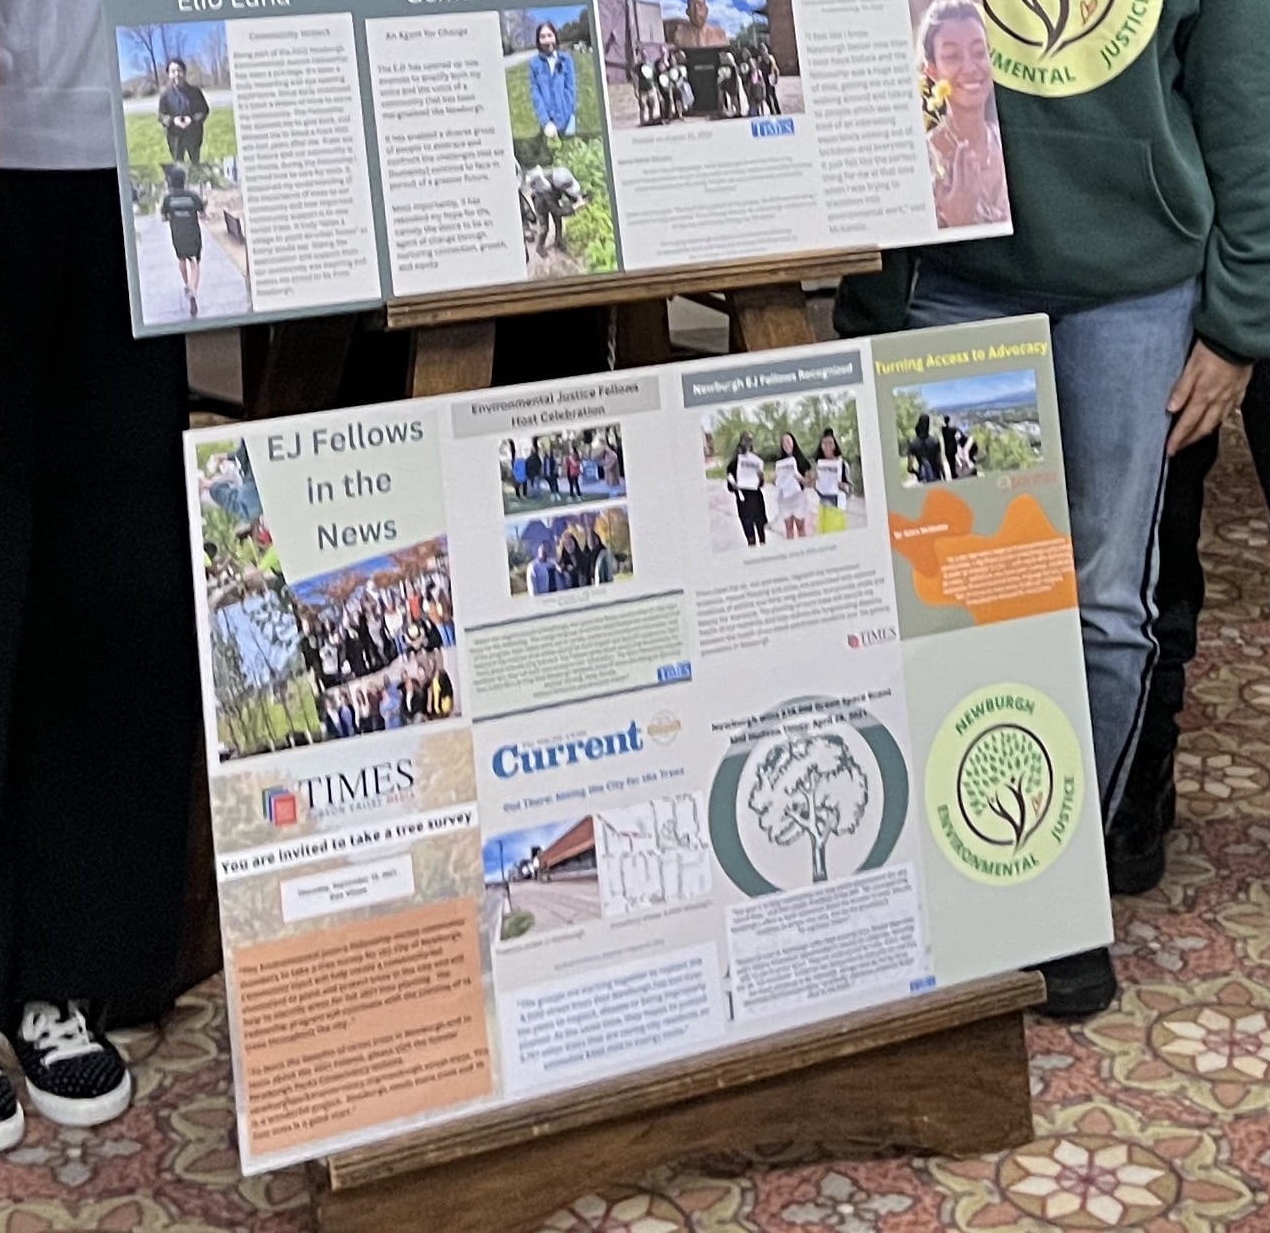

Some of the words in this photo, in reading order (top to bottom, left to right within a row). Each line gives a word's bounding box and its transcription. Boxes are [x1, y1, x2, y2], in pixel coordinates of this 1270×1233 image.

[874, 356, 924, 376] Turning
[925, 351, 969, 369] Access
[971, 350, 986, 362] to
[987, 340, 1050, 362] Advocacy
[471, 394, 555, 415] Environmental
[557, 386, 597, 405] Justice
[598, 381, 640, 400] Fellows
[692, 377, 744, 398] Newburgh
[797, 361, 853, 383] Recognized
[511, 412, 538, 428] Host
[540, 404, 606, 425] Celebration
[267, 434, 302, 463] EJ
[312, 419, 424, 456] Fellows
[307, 476, 334, 505] in
[343, 468, 392, 498] the
[317, 518, 398, 551] News
[955, 695, 1035, 736] NEWBURGH
[492, 720, 644, 779] Current
[298, 759, 415, 808] TIMES
[1050, 775, 1074, 846] JUSTICE
[221, 858, 249, 875] You
[252, 854, 276, 867] are
[280, 839, 328, 863] invited
[332, 836, 347, 851] to
[350, 828, 381, 847] take
[385, 826, 394, 838] a
[395, 820, 424, 837] tree
[428, 810, 473, 832] survey
[937, 804, 1040, 877] ENVIRONMENTAL
